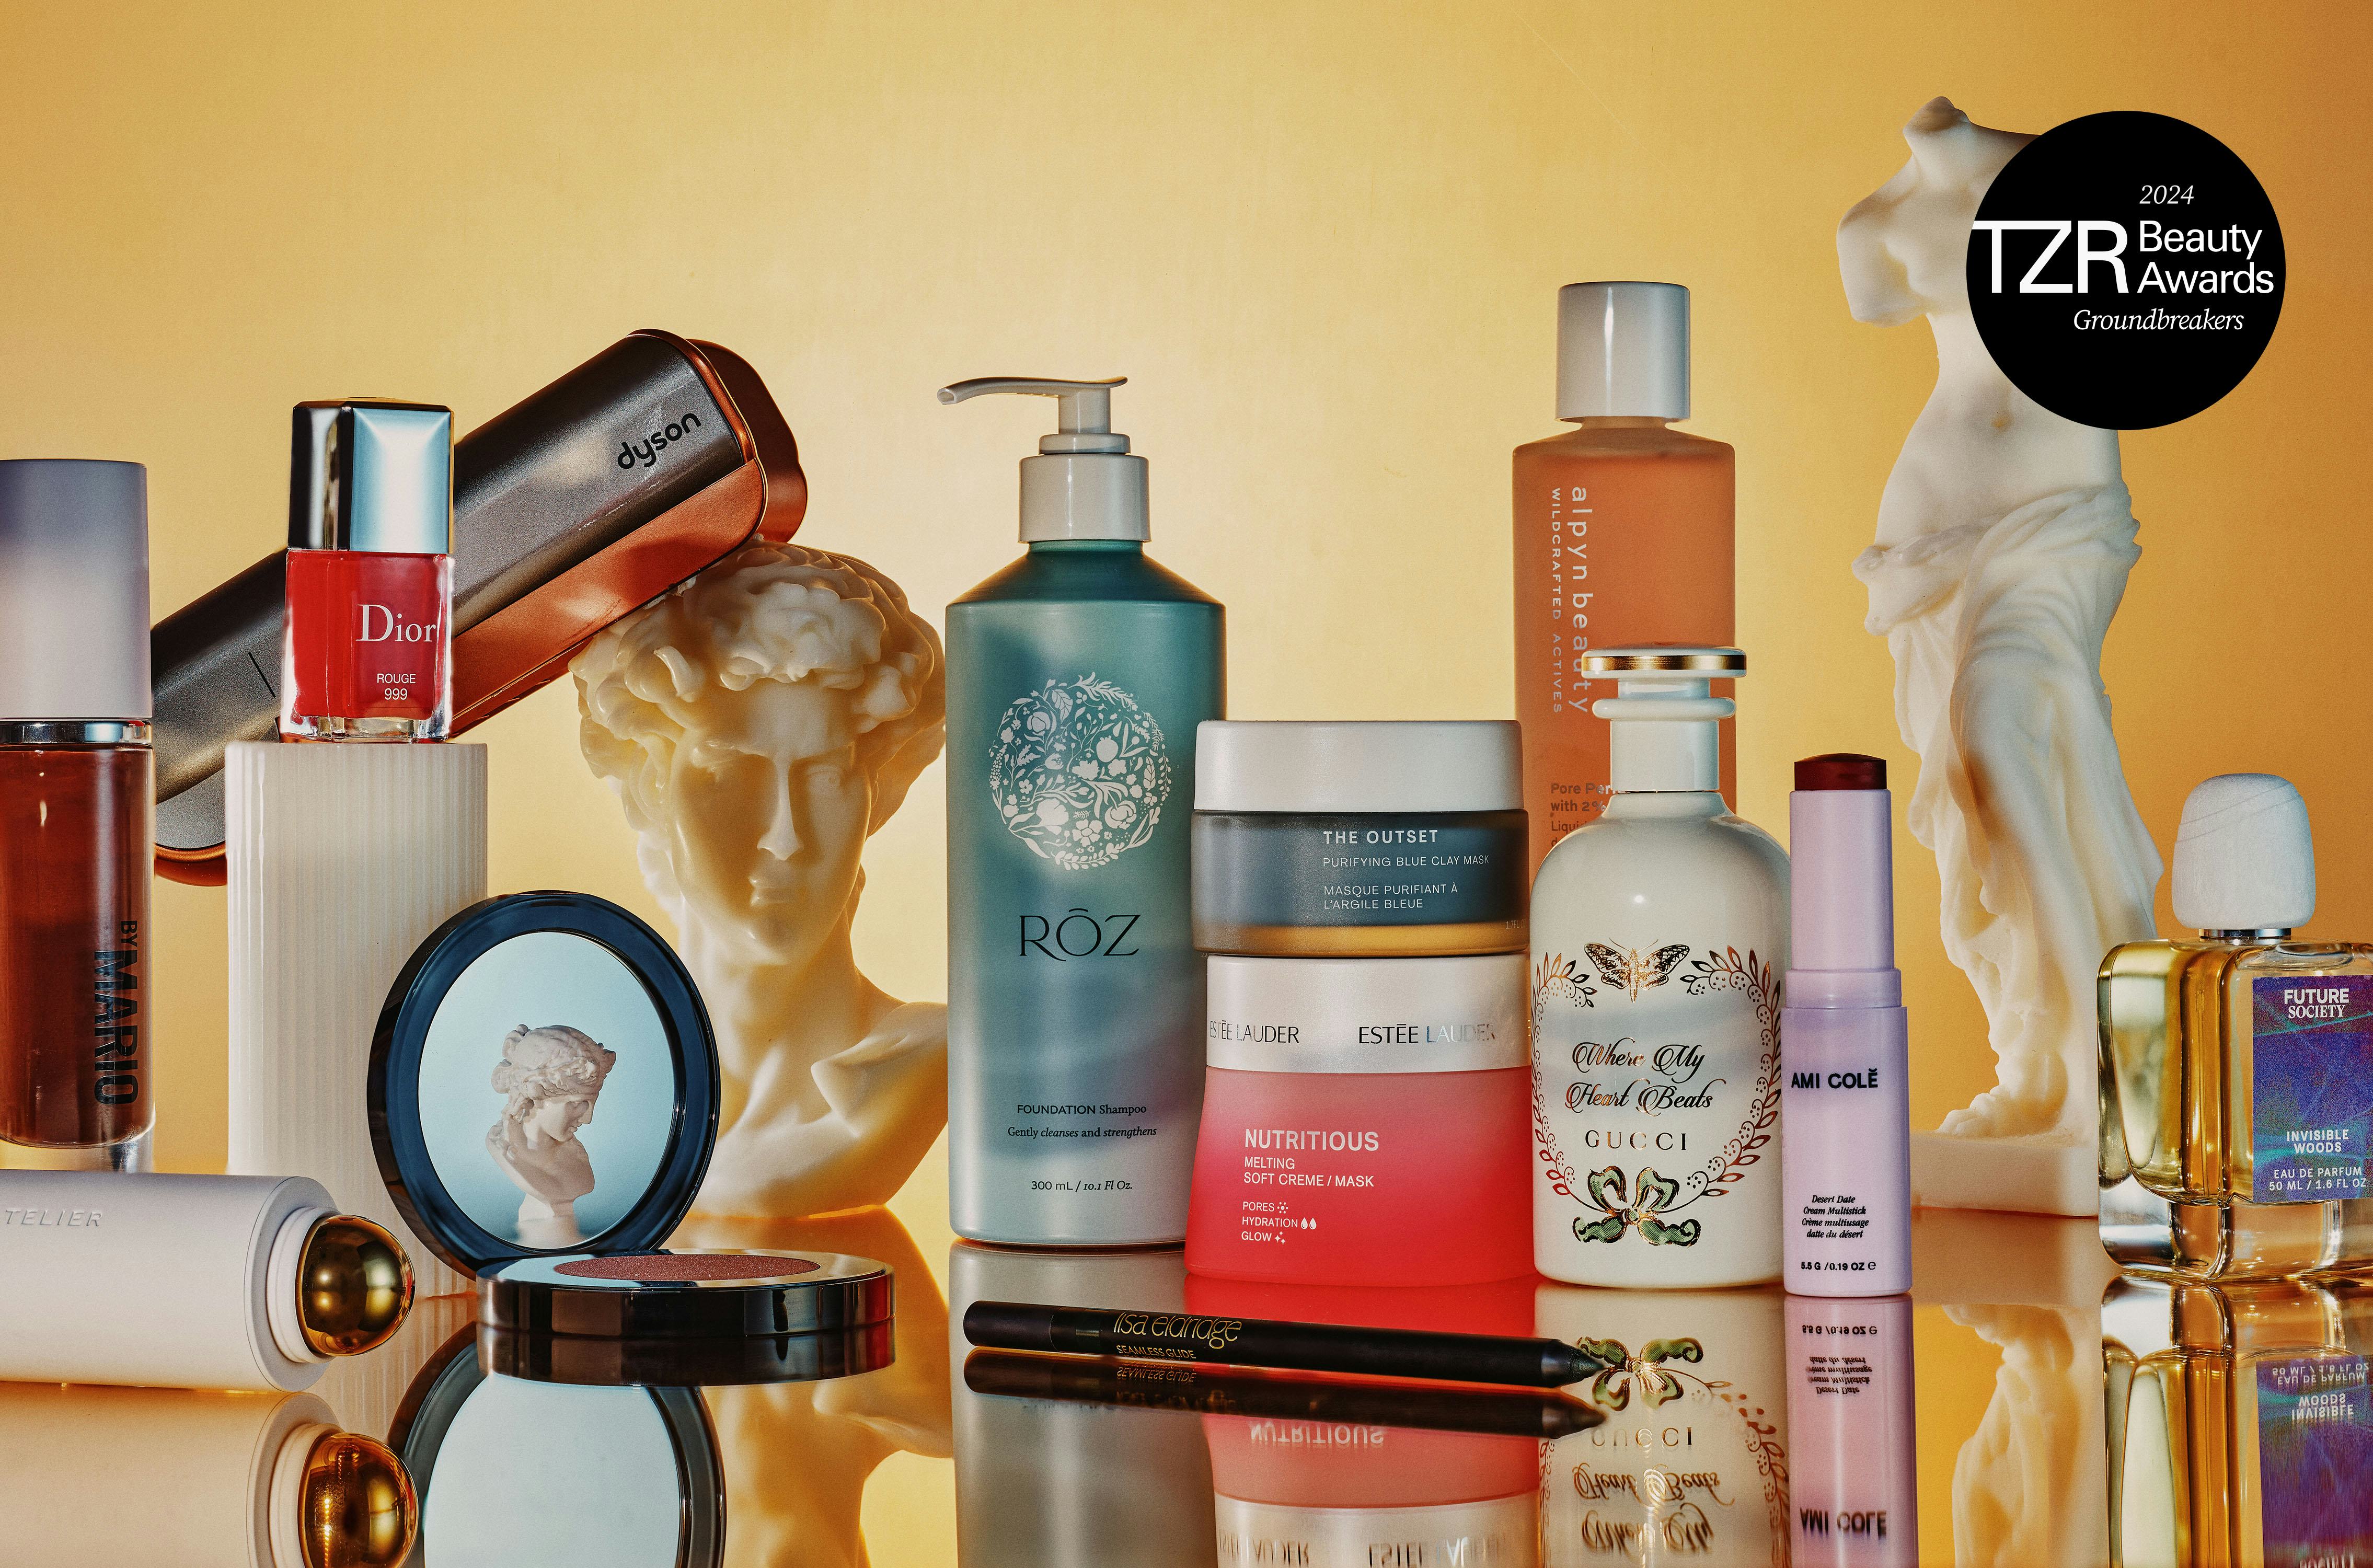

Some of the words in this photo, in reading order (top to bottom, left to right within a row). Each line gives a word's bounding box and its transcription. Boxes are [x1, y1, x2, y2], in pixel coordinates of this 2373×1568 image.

[617, 412, 701, 470] dyson
[1568, 486, 1593, 580] alpyn
[1551, 488, 1560, 620] WILDCRAFTED
[356, 604, 437, 643] Dior
[1569, 593, 1593, 712] beauty
[377, 673, 416, 684] ROUGE
[1553, 633, 1562, 712] ACTIVES
[384, 687, 408, 701] 999
[1551, 783, 1581, 794] Pore
[1585, 783, 1619, 794] Per
[1551, 800, 1577, 812] with
[1323, 831, 1357, 844] THE
[1366, 829, 1438, 844] OUTSET
[1323, 856, 1391, 867] PURIFYING
[1396, 856, 1427, 866] BLUE
[1431, 855, 1460, 866] CLAY
[1464, 855, 1490, 865] MASK
[1324, 885, 1379, 897] MASQUE
[1384, 884, 1446, 895] PURIFIANT
[1385, 898, 1423, 909] BLEUE
[121, 920, 137, 947] BY
[2284, 988, 2349, 1005] FUTURE
[2288, 1005, 2346, 1019] SOCIETY
[94, 950, 139, 1105] MARIO
[1237, 1024, 1299, 1043] LAUDER
[1426, 1023, 1495, 1043] LAUDER
[1572, 1037, 1646, 1074] Where
[1652, 1044, 1705, 1083] My
[1791, 1073, 1819, 1089] AMI
[1565, 1078, 1650, 1114] Heart
[1635, 1079, 1726, 1117] Beats
[1017, 1104, 1096, 1114] FOUNDATION
[1099, 1104, 1146, 1116] Shampoo
[1008, 1127, 1039, 1139] Gently
[1041, 1127, 1078, 1137] cleanses
[1081, 1127, 1101, 1137] and
[1103, 1126, 1157, 1139] strengthens
[2287, 1129, 2349, 1143] INVISIBLE
[1245, 1129, 1379, 1151] NUTRITIOUS
[1585, 1129, 1687, 1151] GUCCI
[2294, 1142, 2342, 1155] WOODS
[1245, 1157, 1295, 1170] MELTING
[1243, 1172, 1274, 1185] SOFT
[1278, 1173, 1324, 1186] CREME
[1335, 1174, 1374, 1187] MASK
[2274, 1169, 2295, 1179] EAU
[2299, 1168, 2313, 1178] DE
[2318, 1166, 2362, 1177] PARFUM
[1031, 1181, 1052, 1190] 300
[1056, 1181, 1073, 1191] mL
[1105, 1180, 1114, 1191] Fl
[1116, 1180, 1133, 1190] Oz.
[2269, 1181, 2283, 1191] 50
[2287, 1181, 2302, 1190] ML
[2316, 1179, 2332, 1189] 1.6
[2336, 1178, 2348, 1188] FL
[2352, 1178, 2366, 1187] OZ
[1812, 1195, 1835, 1203] Desert
[1242, 1201, 1275, 1212] PORES
[1803, 1207, 1825, 1215] Cream
[1827, 1207, 1866, 1215] Multistick
[5, 1208, 103, 1227] TELIER
[1242, 1216, 1298, 1228] HYDRATION
[1802, 1218, 1823, 1227] Crème
[1824, 1218, 1869, 1228] multiusage
[1241, 1230, 1272, 1242] GLOW
[1806, 1229, 1824, 1238] datte
[1826, 1229, 1837, 1238] du
[1839, 1229, 1863, 1239] désert
[1801, 1262, 1812, 1270] 5.5
[1114, 1311, 1149, 1335] lisa
[1151, 1315, 1242, 1349] eldridge
[1116, 1345, 1165, 1357] SEAMLESS
[1166, 1348, 1196, 1359] GLIDE
